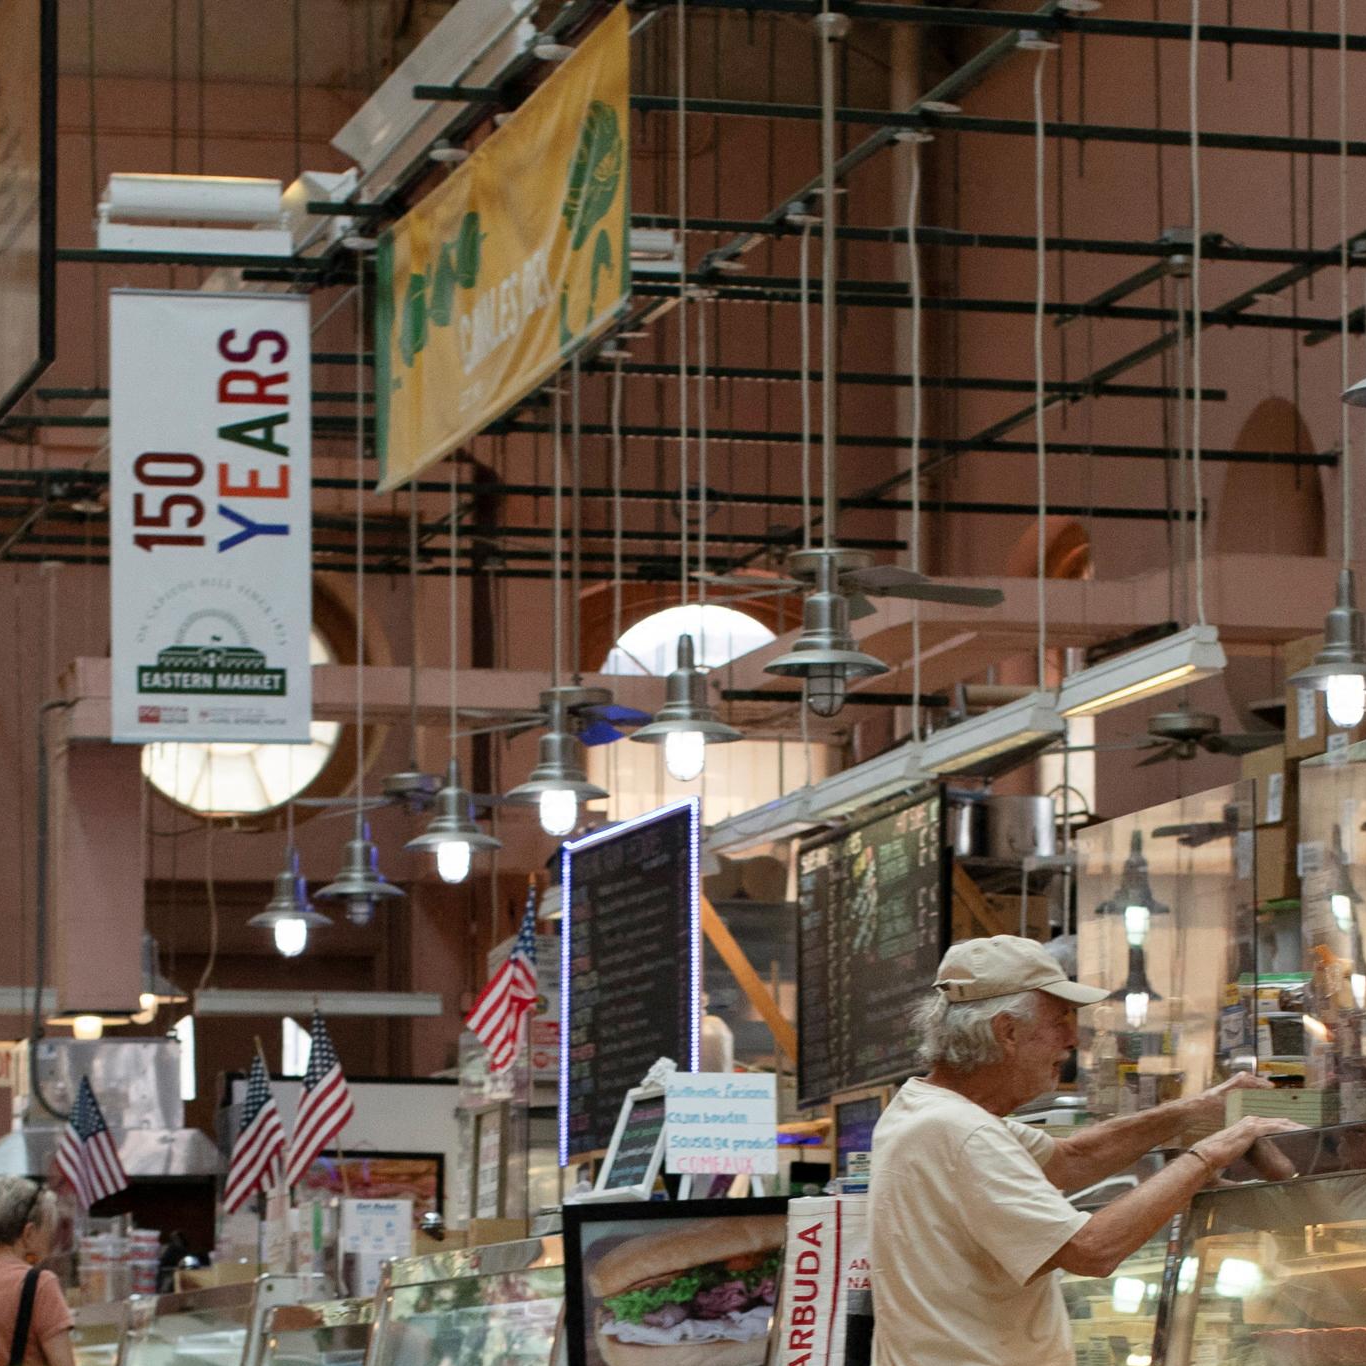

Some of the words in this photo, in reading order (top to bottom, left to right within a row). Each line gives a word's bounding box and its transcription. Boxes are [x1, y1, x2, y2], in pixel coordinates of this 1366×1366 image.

[217, 328, 290, 553] YEARS
[133, 451, 205, 553] 150
[141, 671, 214, 689] EASTERN
[216, 673, 283, 690] MARKET
[849, 1258, 871, 1271] AN
[847, 1277, 872, 1290] NA
